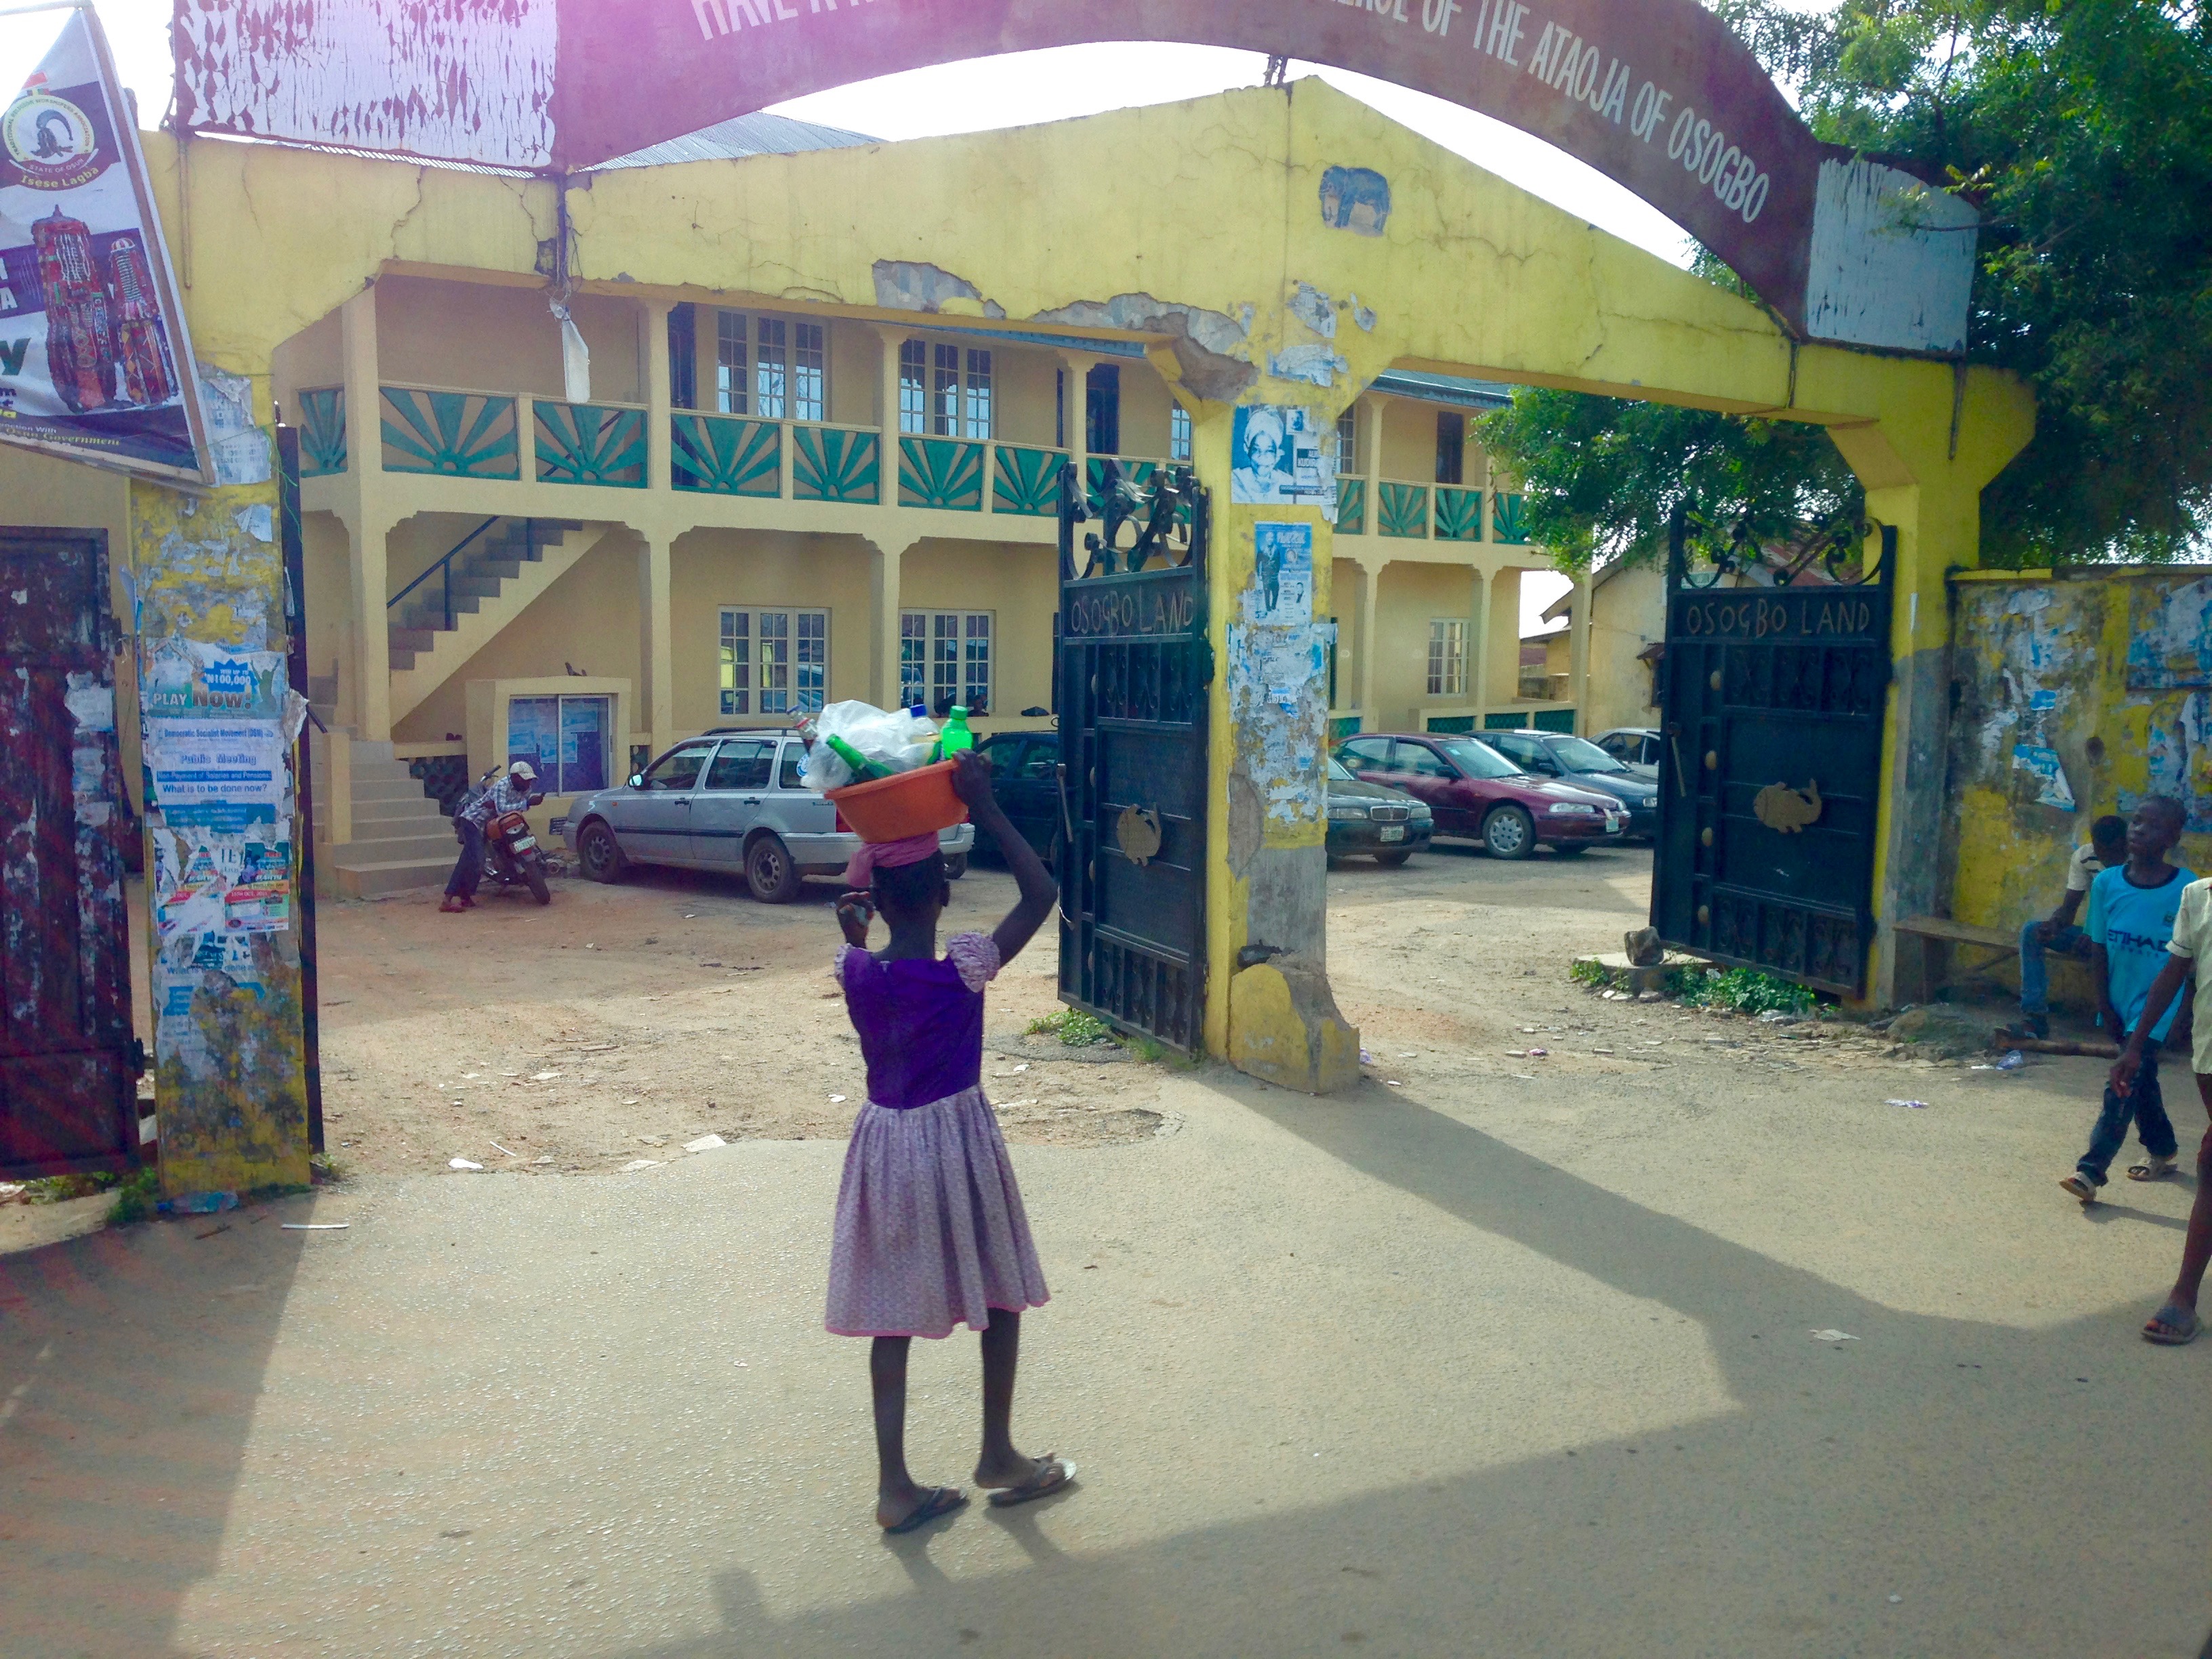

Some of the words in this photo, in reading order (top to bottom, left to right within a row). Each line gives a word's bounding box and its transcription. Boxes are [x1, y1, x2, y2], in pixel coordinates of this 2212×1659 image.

[691, 0, 799, 41] HA
[1473, 0, 1531, 66] THE
[1528, 20, 1631, 125] ATAOJA
[1631, 81, 1674, 144] OF
[1667, 106, 1770, 224] OSOGBO
[43, 433, 121, 446] Government
[1071, 590, 1133, 637] OSOGBO
[1139, 585, 1193, 634] LAND
[1687, 598, 1787, 638] OSOGBO
[1801, 600, 1870, 634] LAND
[153, 693, 188, 705] PLAY
[216, 753, 257, 766] Meeting
[162, 784, 185, 794] What
[187, 784, 194, 793] is
[197, 785, 205, 793] to
[220, 784, 243, 792] done
[244, 783, 268, 792] now?
